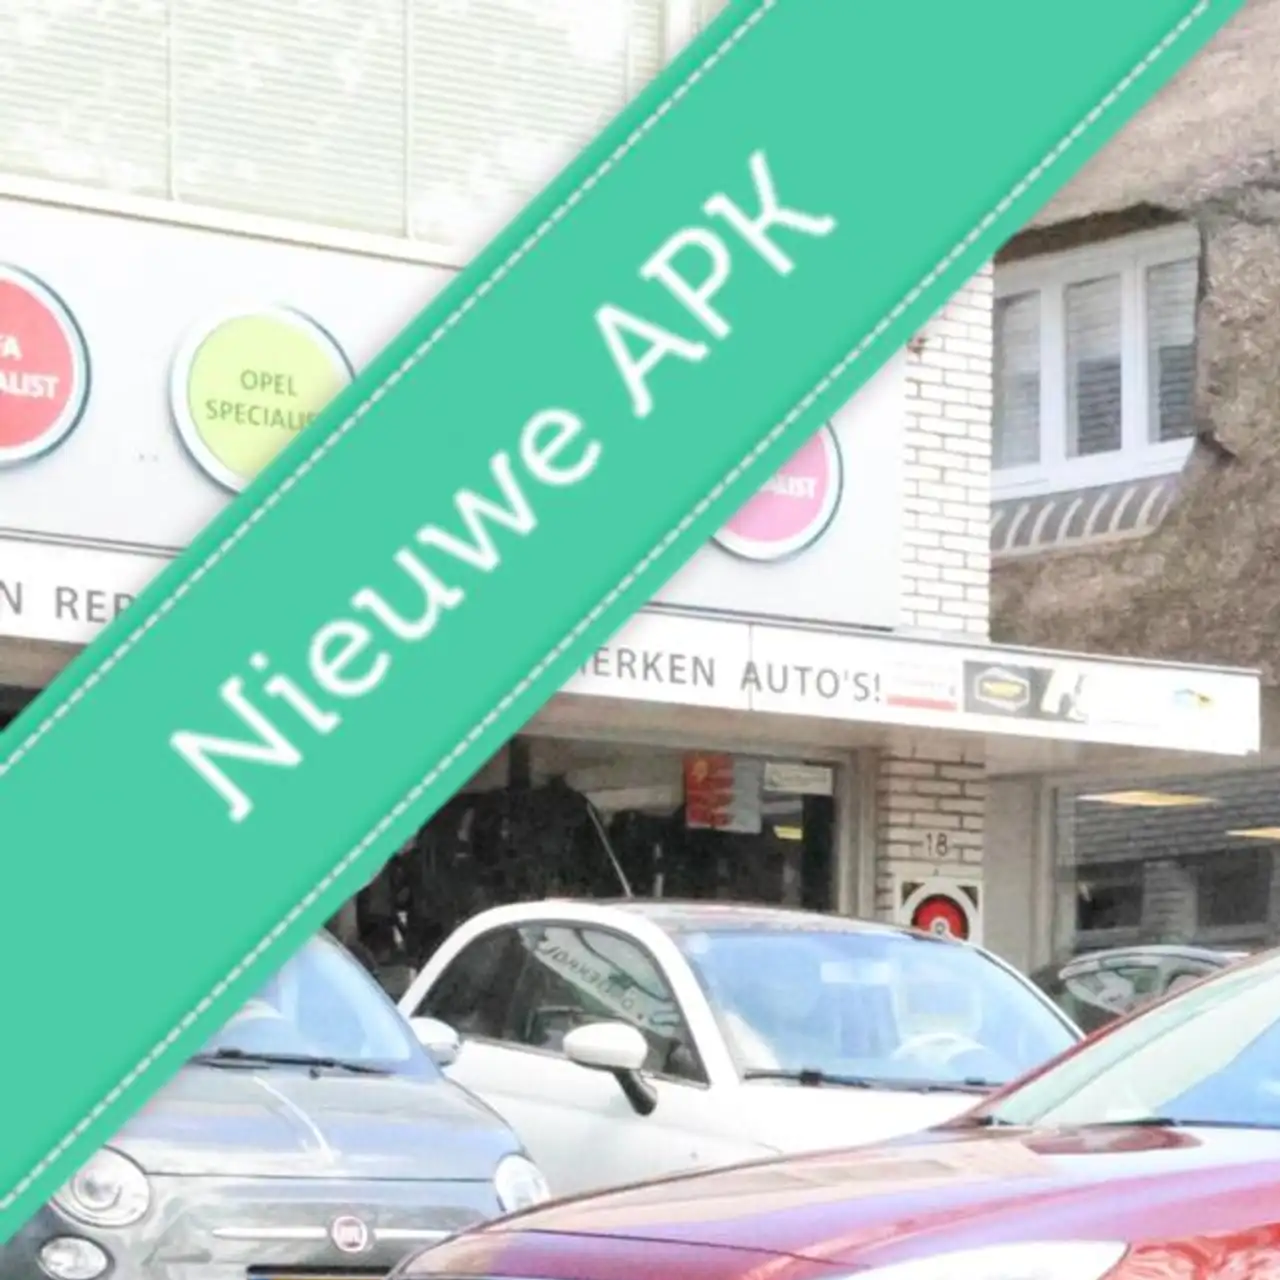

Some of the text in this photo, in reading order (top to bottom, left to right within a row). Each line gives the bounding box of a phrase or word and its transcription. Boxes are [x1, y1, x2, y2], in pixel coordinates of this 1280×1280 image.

[239, 367, 299, 398] OPEL
[740, 658, 882, 704] AUTO'S!
[926, 830, 949, 857] 18
